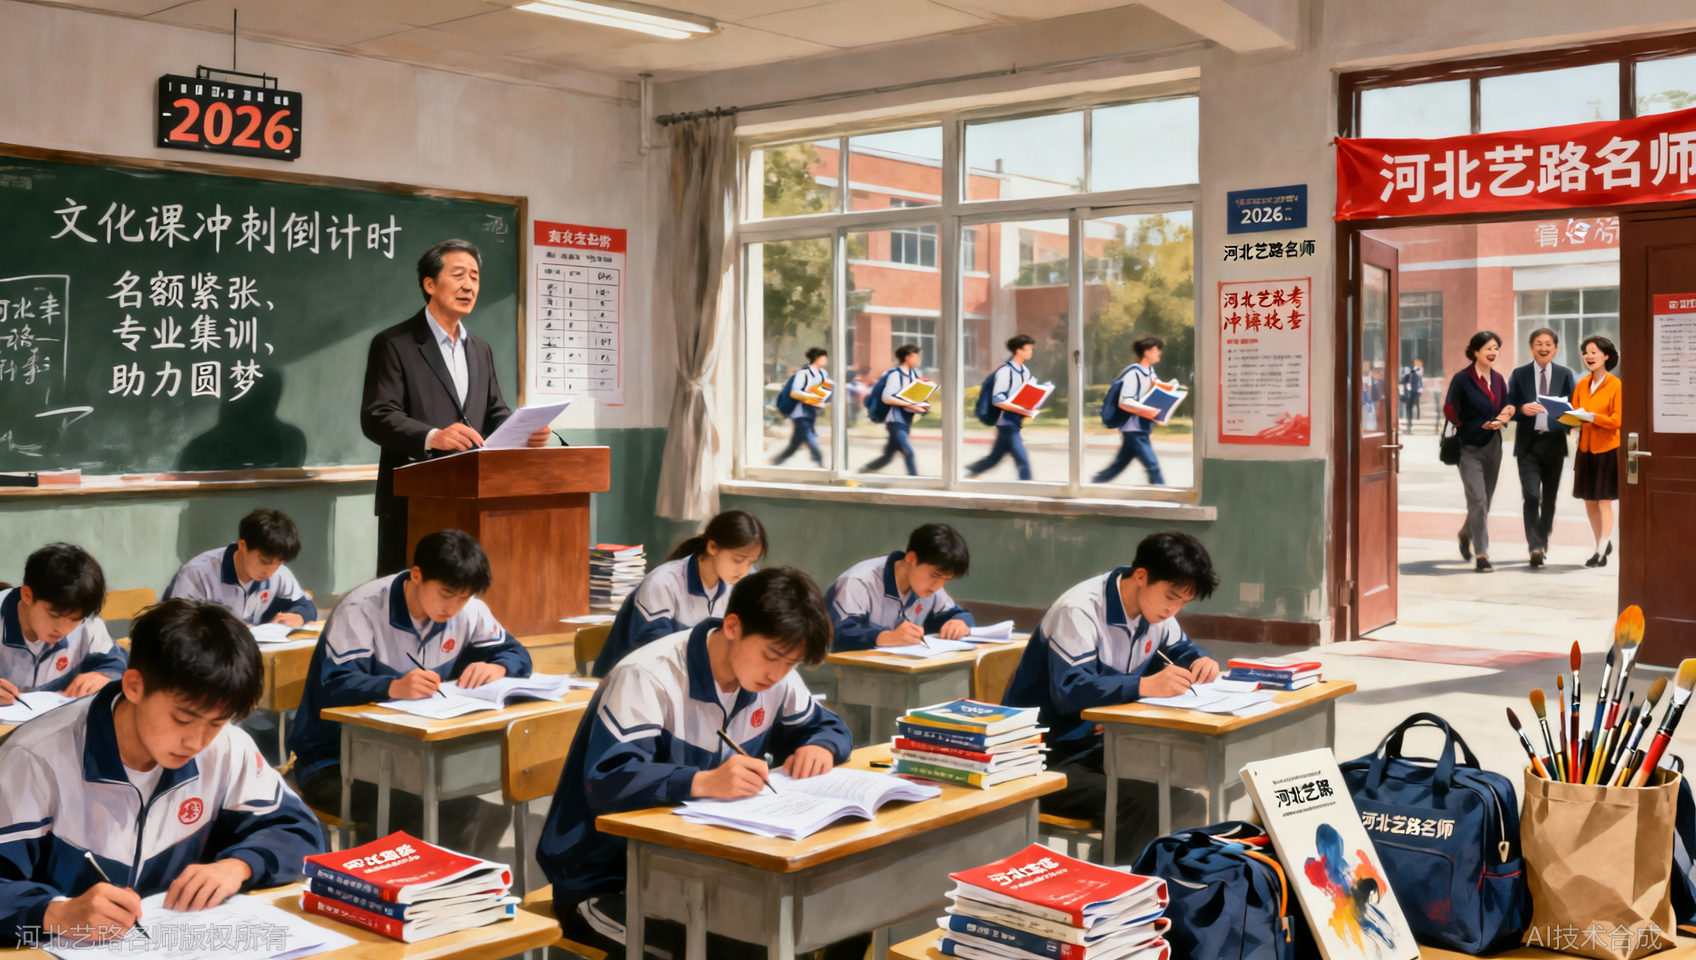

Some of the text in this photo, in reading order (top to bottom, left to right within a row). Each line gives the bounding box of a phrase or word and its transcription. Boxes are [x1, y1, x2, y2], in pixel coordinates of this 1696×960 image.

[169, 98, 293, 151] 2026
[1380, 131, 1696, 203] 河北艺路名师
[50, 197, 402, 259] 文化课冲刺倒计时
[1240, 206, 1283, 224] 2026
[1223, 239, 1316, 261] 河北艺路名师
[106, 270, 275, 310] 名额紧张、
[112, 314, 275, 355] 专业集训、
[108, 360, 264, 402] 助力圆梦
